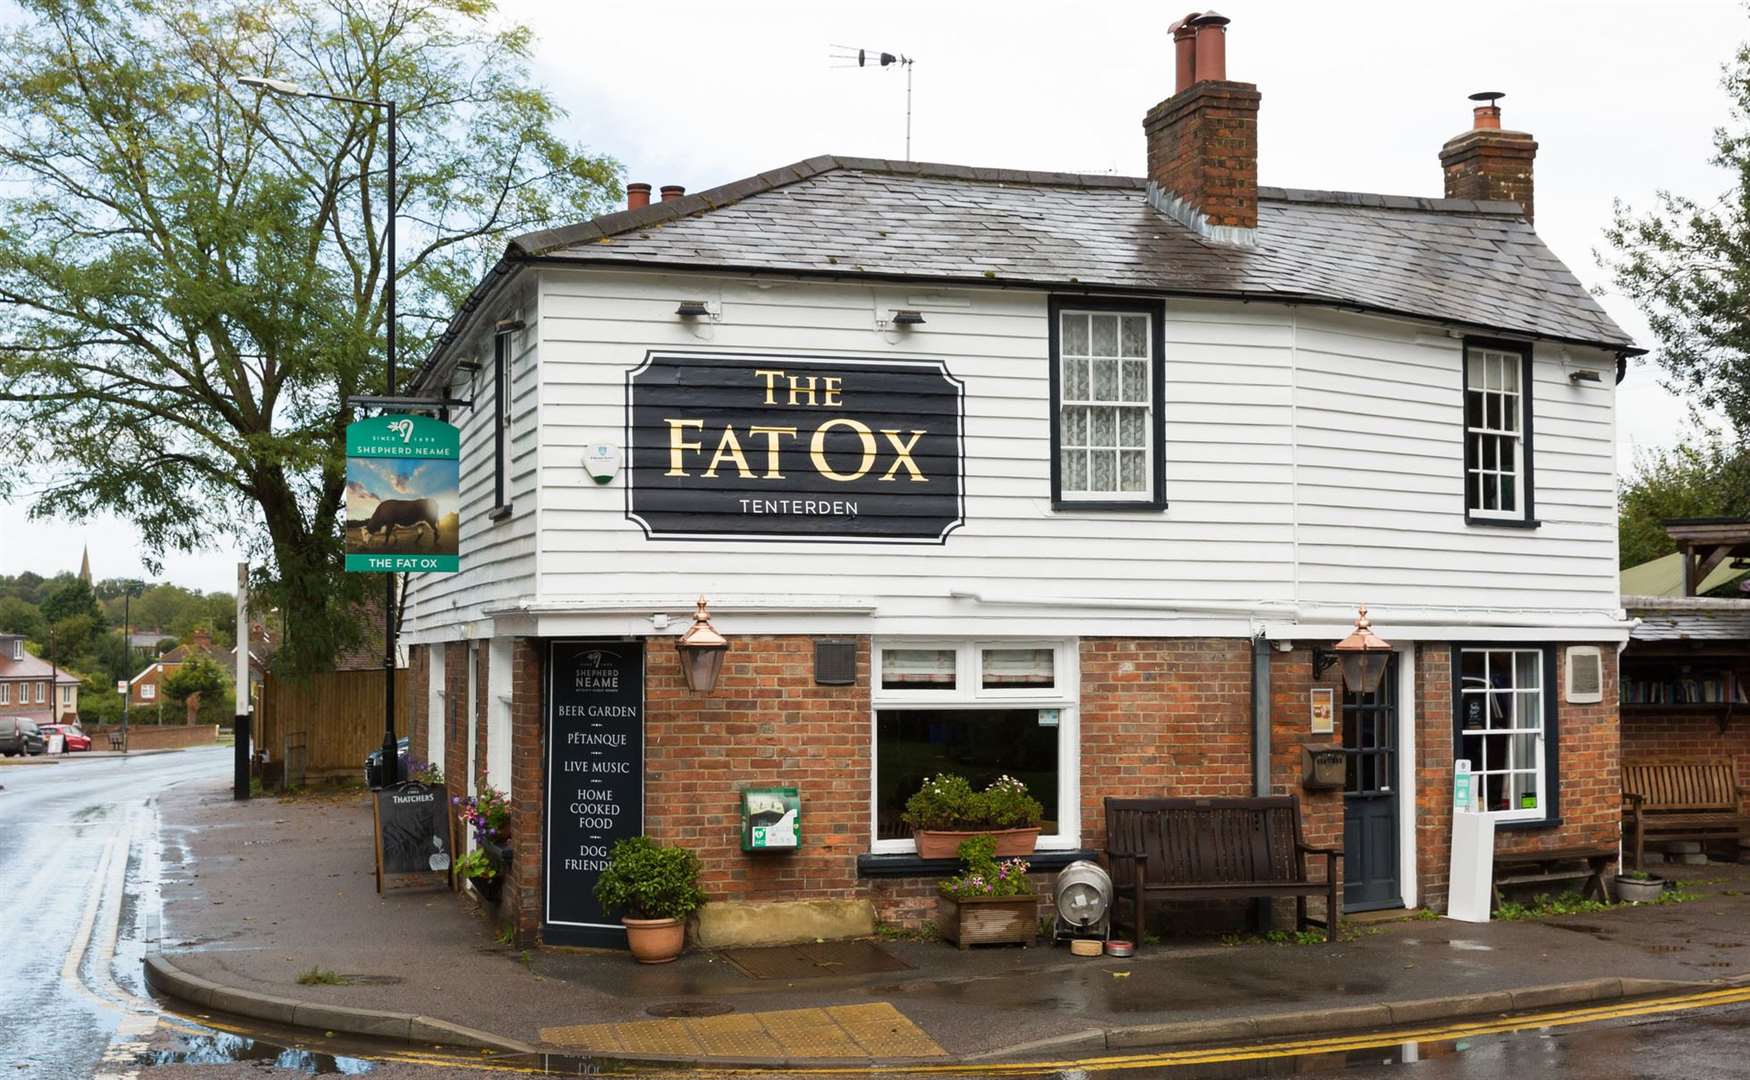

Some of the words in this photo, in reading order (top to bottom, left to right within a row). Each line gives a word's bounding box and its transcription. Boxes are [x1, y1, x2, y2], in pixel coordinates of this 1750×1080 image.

[755, 369, 843, 407] THE
[357, 446, 412, 455] SHEPHERD
[415, 447, 451, 456] NEAME
[663, 418, 797, 480] FAT
[810, 418, 929, 482] OX
[739, 499, 859, 515] TENTERDEN
[368, 558, 392, 568] THE
[396, 558, 418, 568] FAT
[420, 558, 438, 568] OX
[575, 669, 620, 677] SHEPHERD
[575, 677, 619, 688] NEAME
[559, 705, 586, 717] BEER
[588, 705, 637, 718] GARDEN
[567, 731, 627, 748] PÉTANQUE
[564, 760, 589, 772] LIVE
[592, 761, 630, 774] MUSIC
[577, 789, 613, 801] HOME
[570, 803, 620, 816] COOKED
[579, 817, 613, 829] FOOD
[580, 845, 607, 857] DOG
